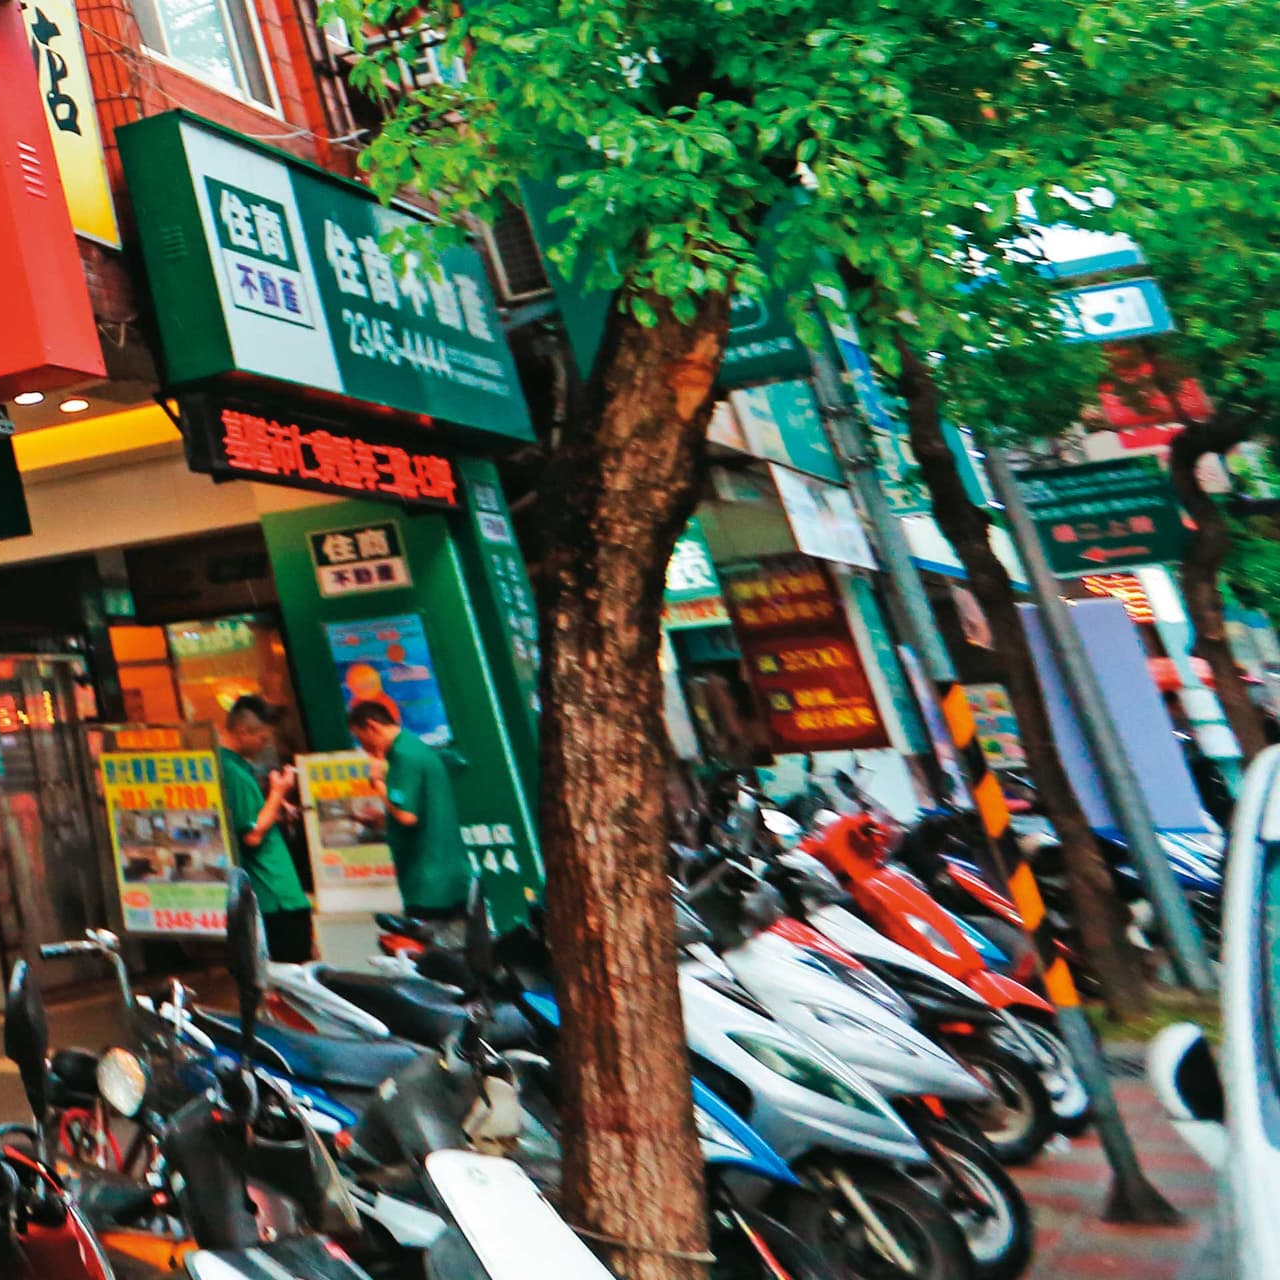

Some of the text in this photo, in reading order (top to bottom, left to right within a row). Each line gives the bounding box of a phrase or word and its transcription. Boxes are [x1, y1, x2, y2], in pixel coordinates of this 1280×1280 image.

[219, 189, 289, 262] 住商
[236, 263, 302, 315] 不動產
